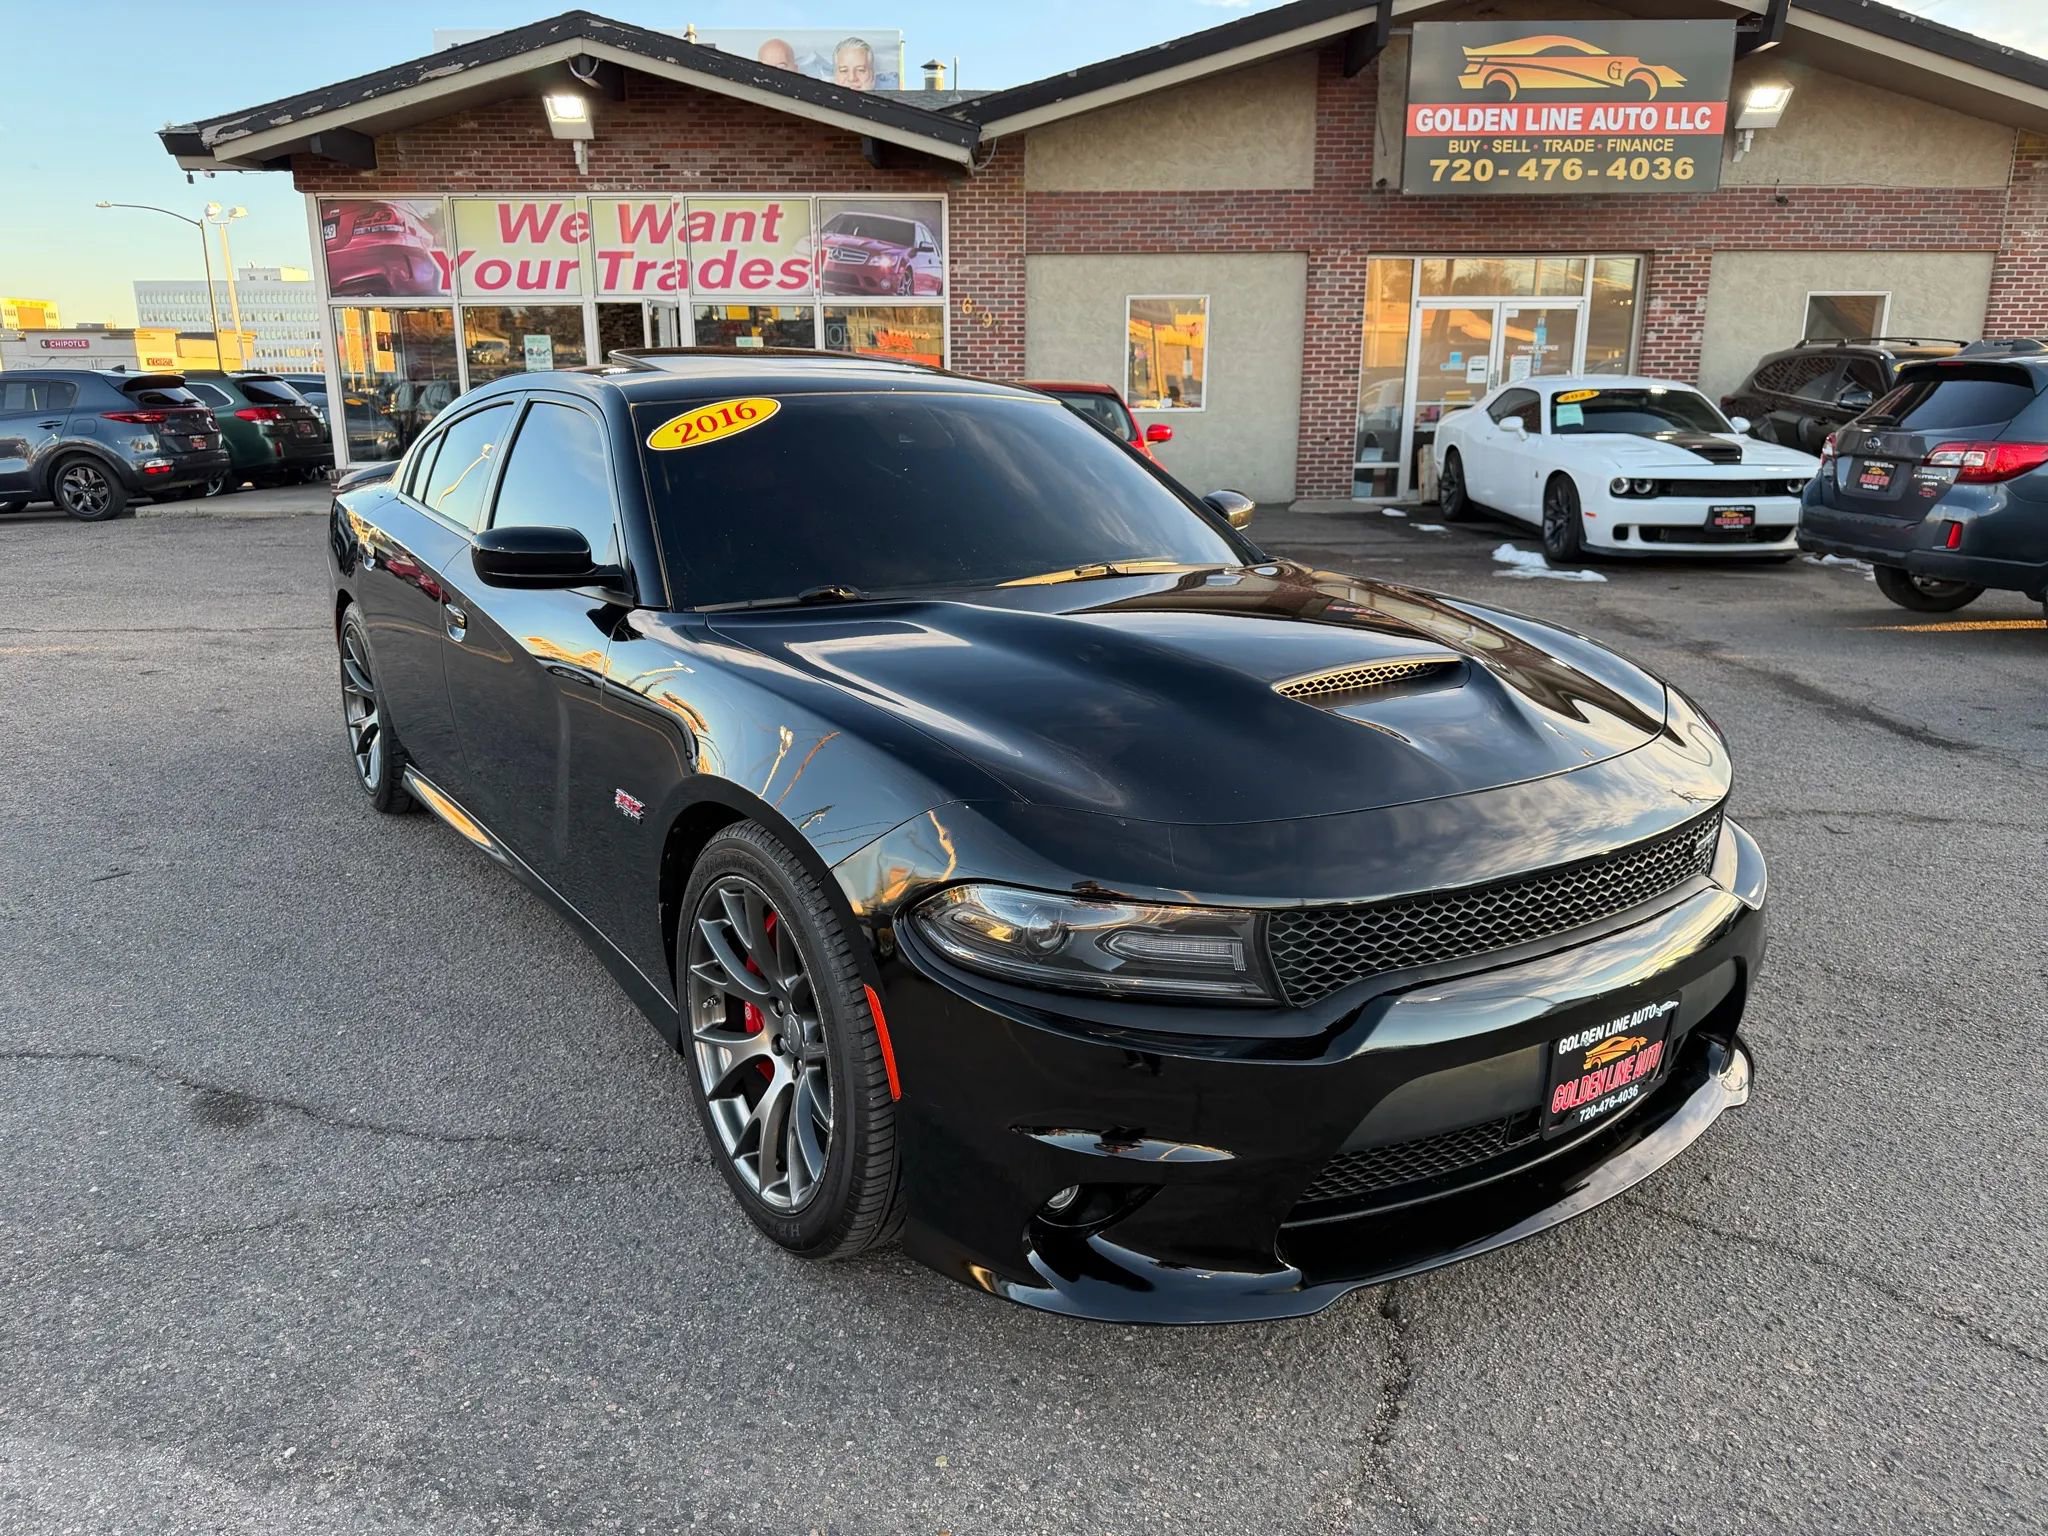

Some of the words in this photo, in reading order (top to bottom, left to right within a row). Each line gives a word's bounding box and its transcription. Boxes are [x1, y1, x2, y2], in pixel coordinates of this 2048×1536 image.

[1415, 107, 1518, 132] GOLDEN
[1525, 107, 1583, 131] LINE
[1588, 107, 1658, 131] AUTO
[1665, 106, 1711, 130] LLC
[1448, 139, 1481, 153] BUY
[1492, 139, 1531, 153] SELL
[1543, 139, 1595, 153] TRADE
[1606, 138, 1674, 152] FINANCE
[497, 203, 590, 244] We
[617, 202, 784, 244] Want
[430, 250, 581, 291] Your
[598, 249, 828, 291] Trades!
[49, 340, 87, 348] CHIPOTLE
[674, 400, 757, 444] 2016
[1558, 1024, 1605, 1055] GOLDEN
[1605, 1015, 1631, 1037] LINE
[1630, 1003, 1657, 1028] AUTO
[1551, 1067, 1607, 1114] GOLDEN
[1606, 1054, 1636, 1092] LINE
[1632, 1040, 1663, 1080] AUTO
[1579, 1084, 1639, 1122] 720-476-4036
